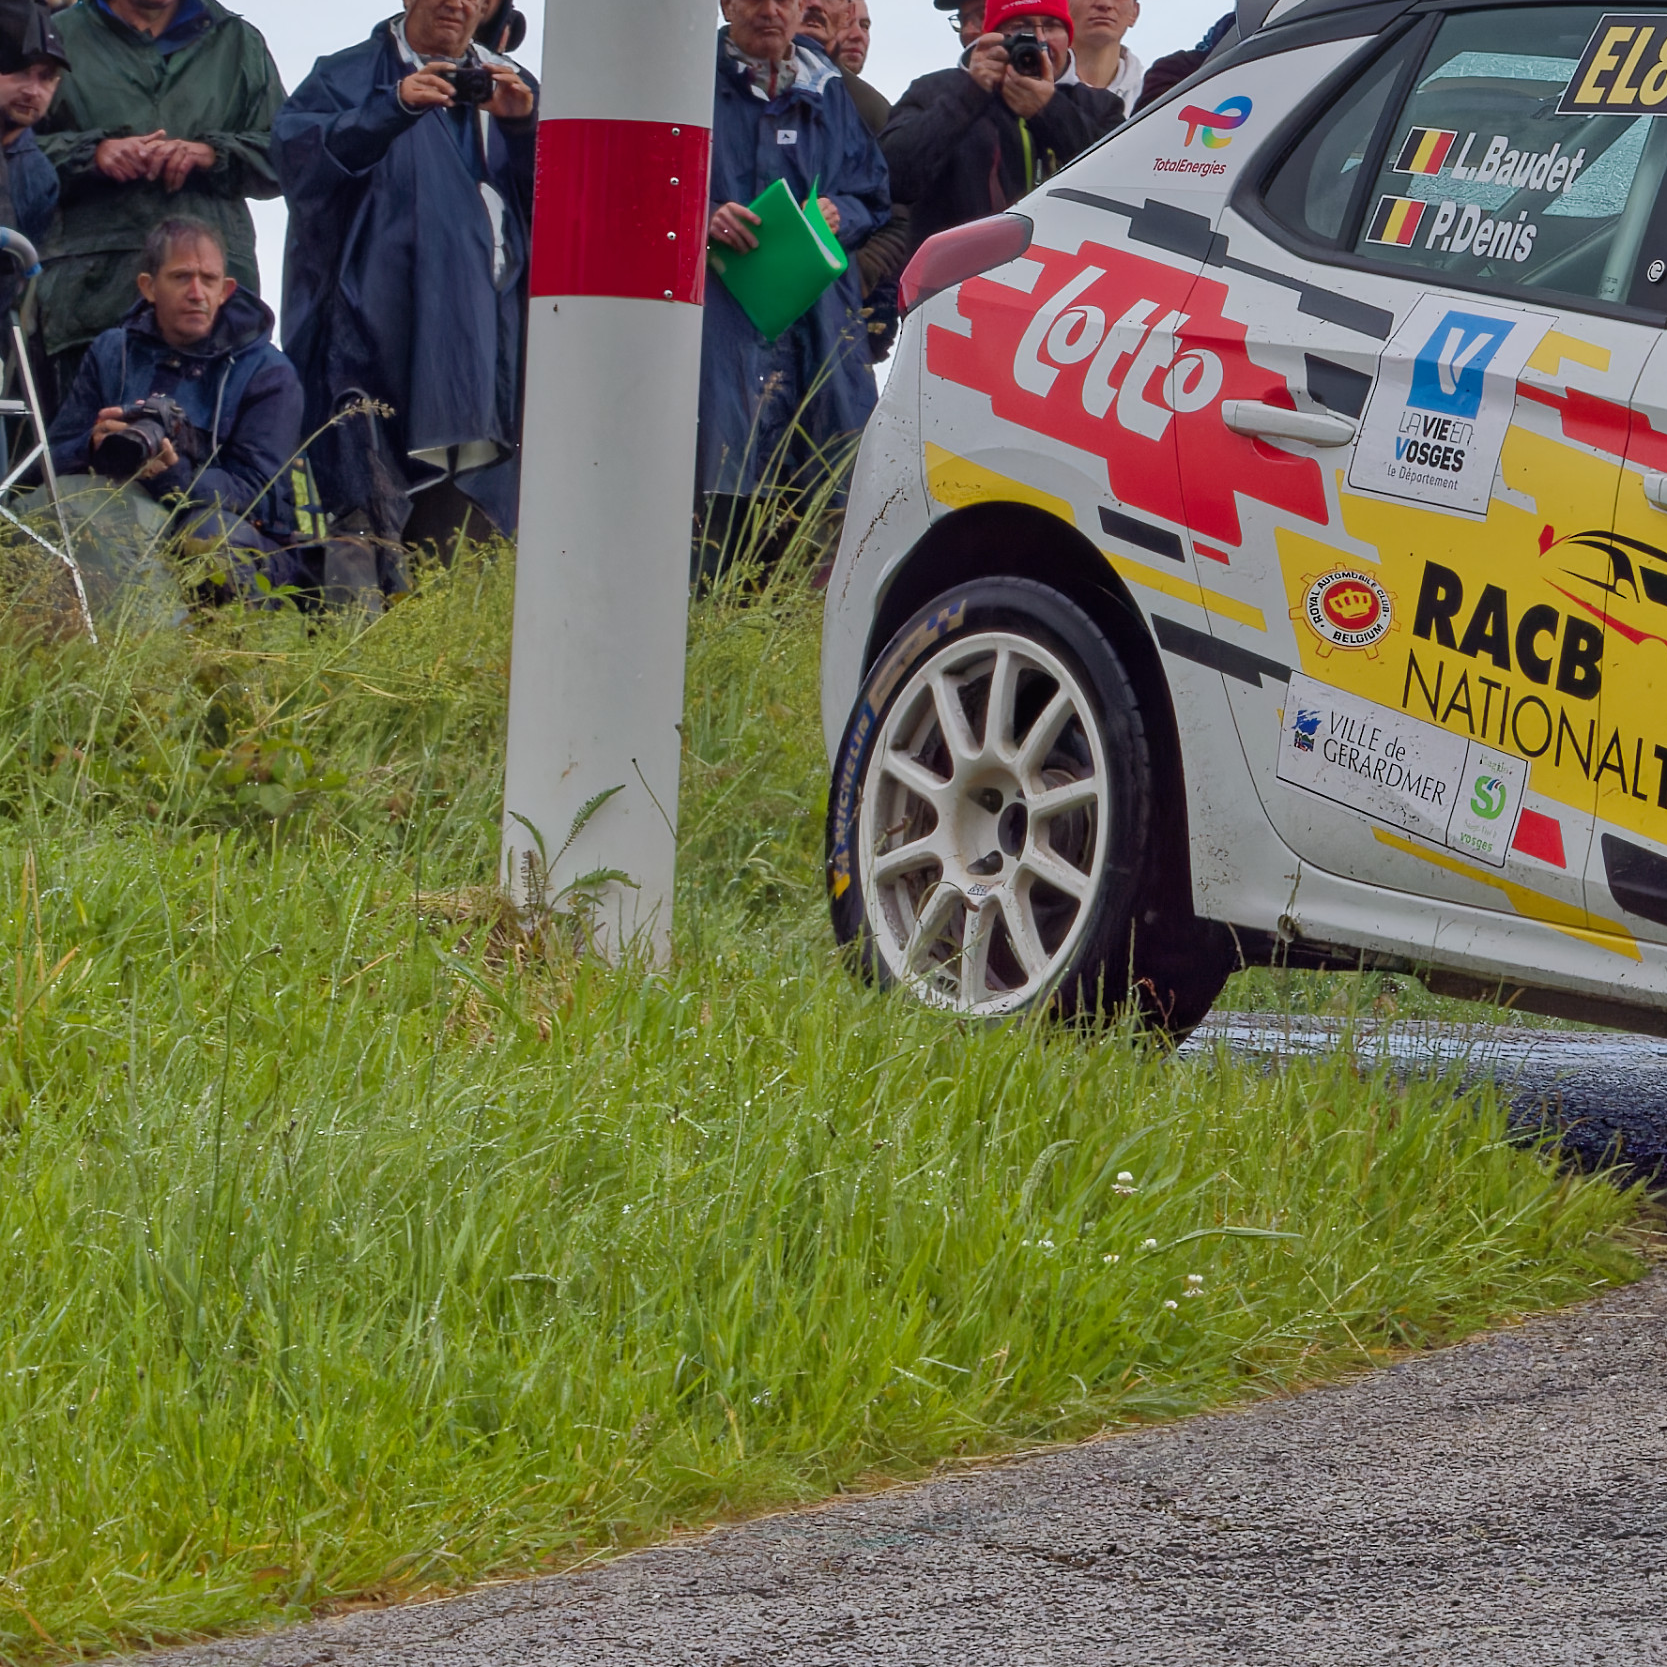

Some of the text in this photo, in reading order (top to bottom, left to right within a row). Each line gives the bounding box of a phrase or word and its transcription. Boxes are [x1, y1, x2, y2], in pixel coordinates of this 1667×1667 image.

[1152, 158, 1227, 178] TotalEnergies
[1449, 131, 1588, 194] L.Baudet
[1424, 200, 1538, 263] P.Denis
[1012, 265, 1224, 442] Lotto
[1395, 436, 1466, 473] VOSGES
[1398, 466, 1460, 491] Département
[1308, 590, 1324, 625] ROYAL
[1376, 589, 1390, 614] CLUB
[1332, 623, 1384, 644] BELGIUM
[1412, 560, 1604, 701] RACB
[1328, 710, 1407, 763] VILLE de
[1322, 738, 1447, 806] GERARDMER
